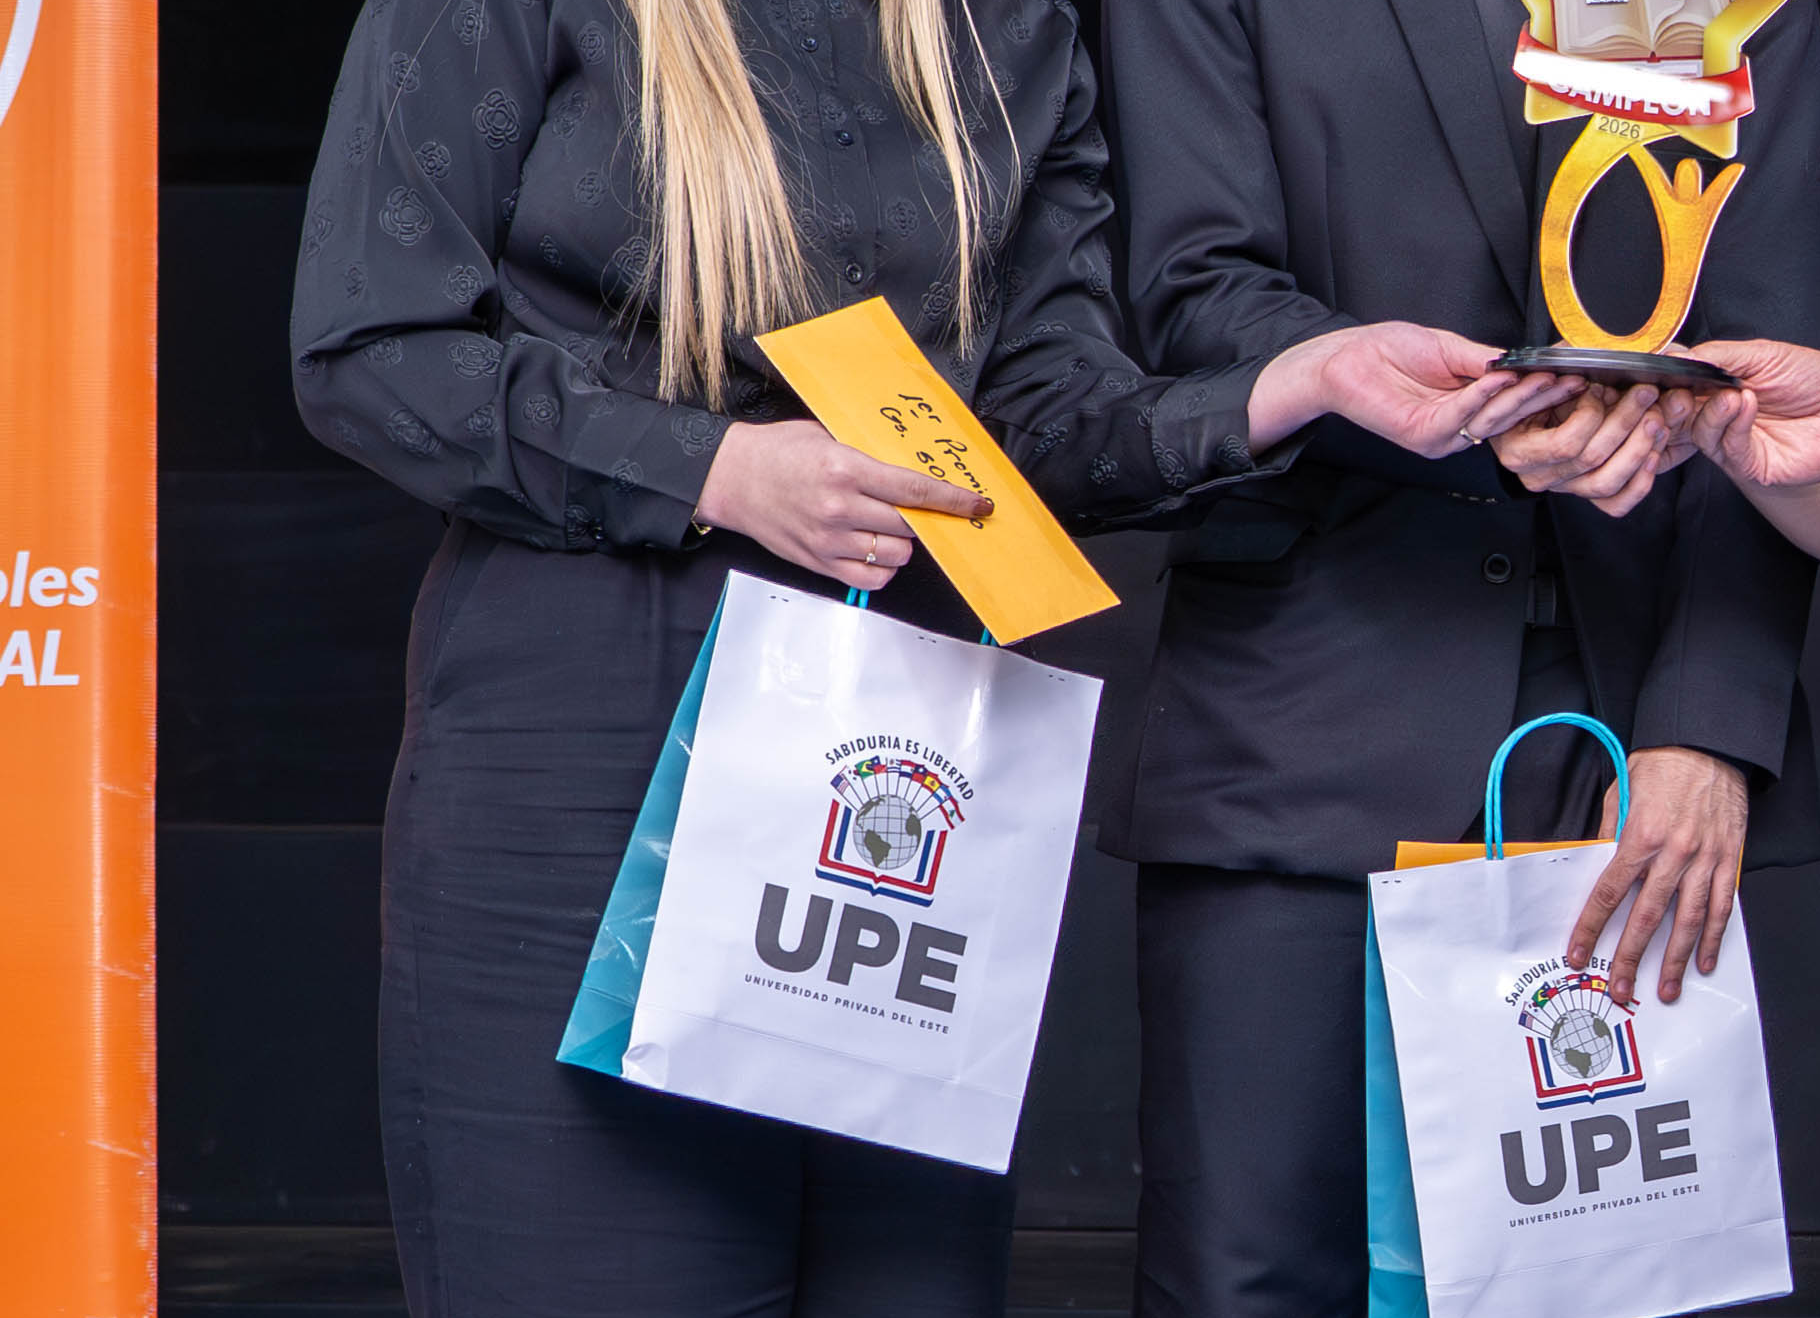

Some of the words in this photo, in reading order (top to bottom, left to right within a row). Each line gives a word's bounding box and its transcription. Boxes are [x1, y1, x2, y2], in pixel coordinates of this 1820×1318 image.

[1598, 116, 1641, 140] 2026
[825, 735, 901, 765] SABIDURIA
[905, 739, 920, 755] ES
[923, 746, 974, 802] LIBERTAD
[754, 882, 969, 1014] UPE
[744, 974, 829, 1002] UNIVERSIDAD
[834, 996, 886, 1018] PRIVADA
[891, 1012, 913, 1026] DEL
[919, 1020, 949, 1035] ESTE
[1505, 958, 1560, 1007] SABIDURIA
[1500, 1100, 1698, 1206] UPE
[1509, 1206, 1587, 1228] UNIVERSIDAD
[1592, 1196, 1641, 1212] PRIVADA
[1646, 1191, 1668, 1202] DEL
[1673, 1184, 1700, 1196] ESTE
